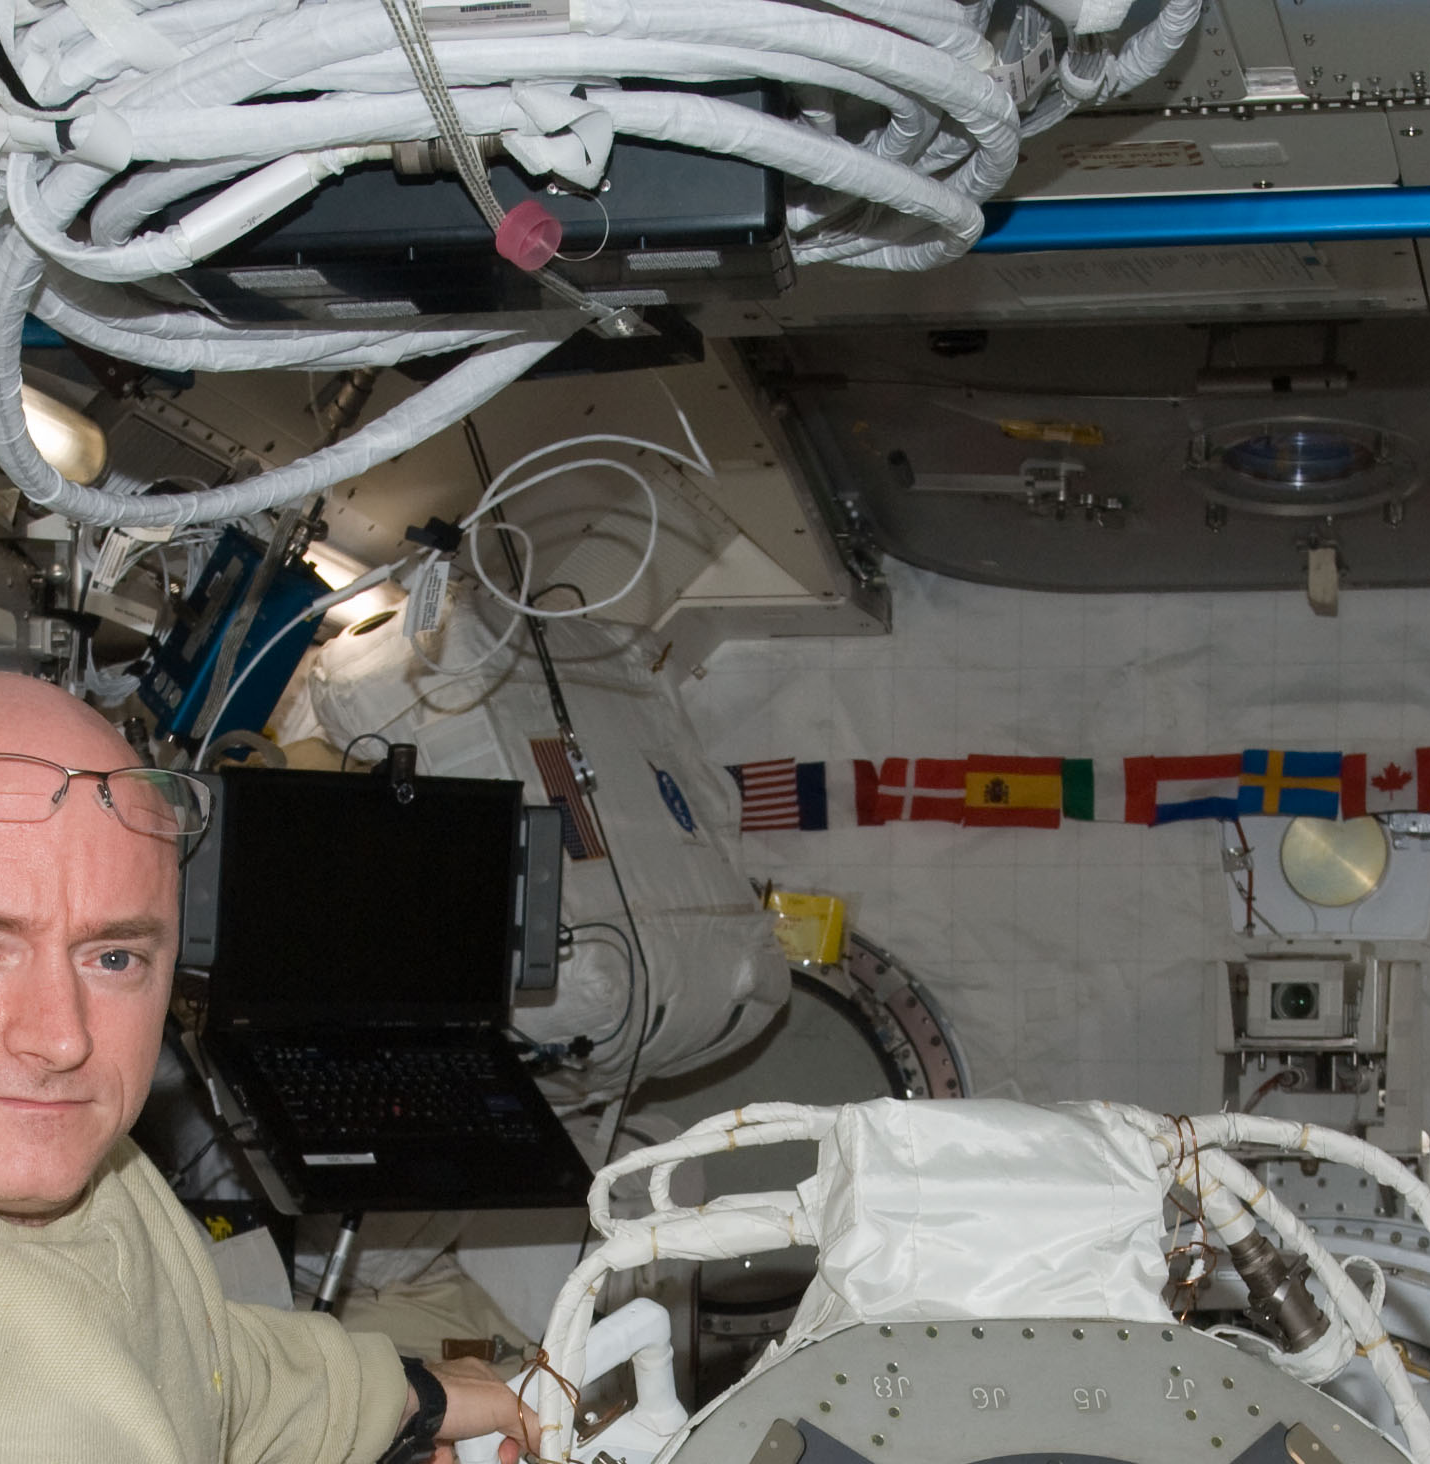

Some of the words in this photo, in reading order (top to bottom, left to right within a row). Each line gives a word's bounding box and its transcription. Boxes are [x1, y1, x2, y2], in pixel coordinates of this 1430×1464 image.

[972, 1387, 1005, 1409] J6
[1074, 1388, 1107, 1409] J5
[1165, 1378, 1195, 1400] J7
